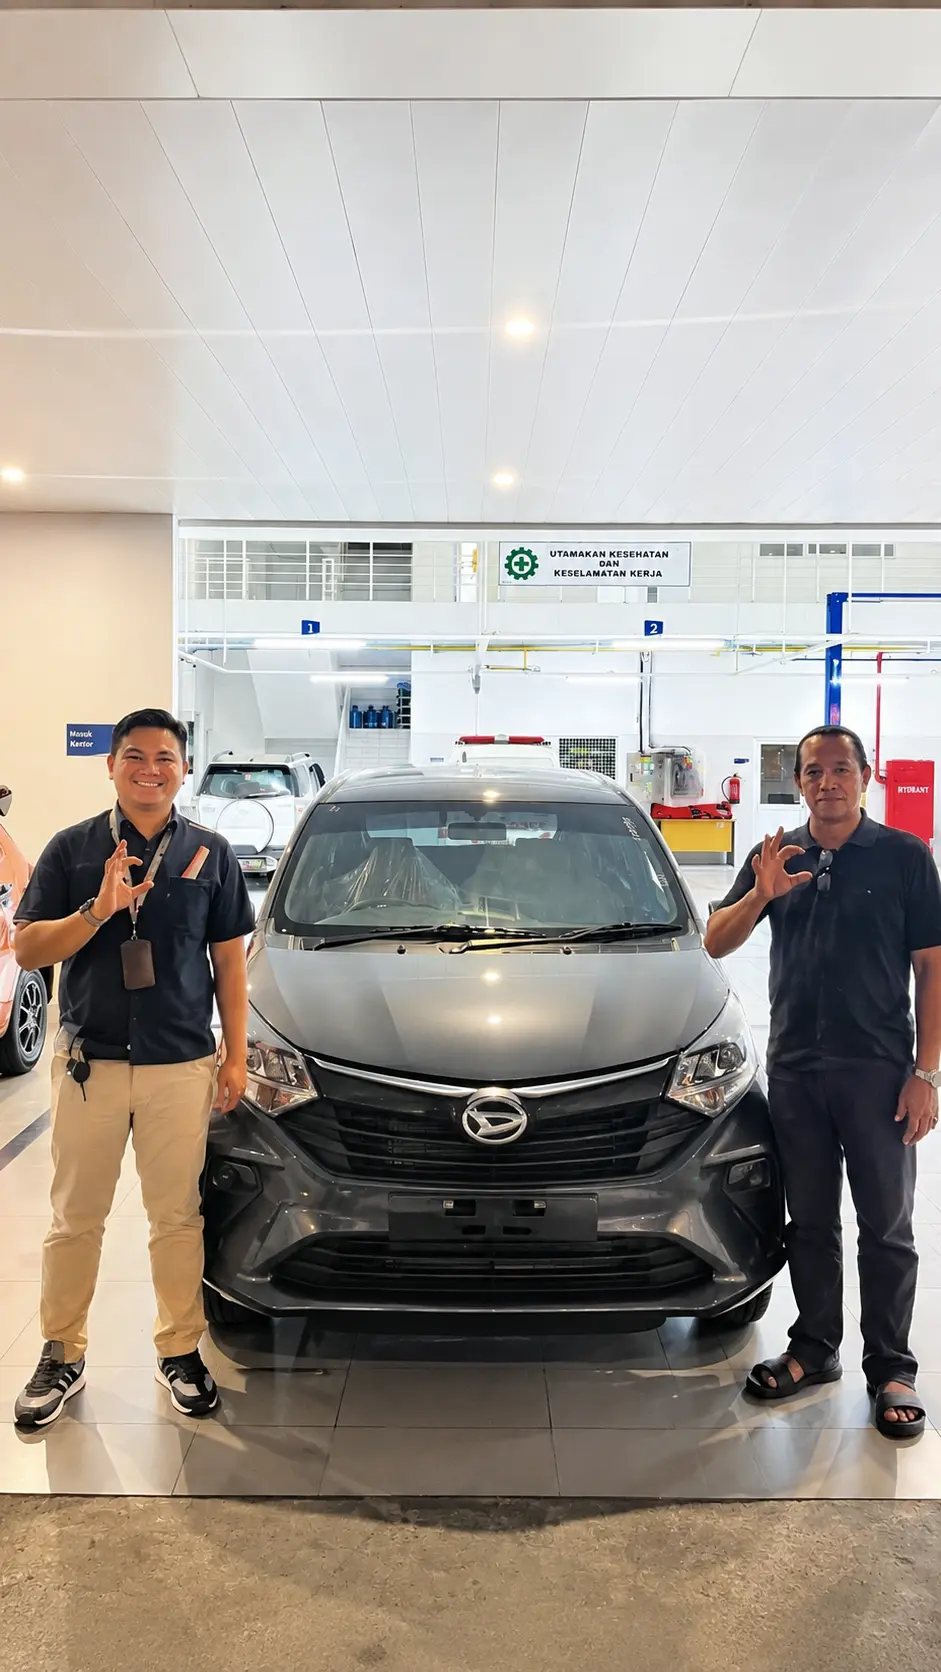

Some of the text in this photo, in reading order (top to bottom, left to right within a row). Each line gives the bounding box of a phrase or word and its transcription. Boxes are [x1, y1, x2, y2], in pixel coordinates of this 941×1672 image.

[549, 550, 669, 559] UTAMAKAN KESEHATAN
[553, 569, 663, 578] KESELAMATAN KERJA
[307, 623, 313, 633] 1
[650, 623, 658, 634] 2
